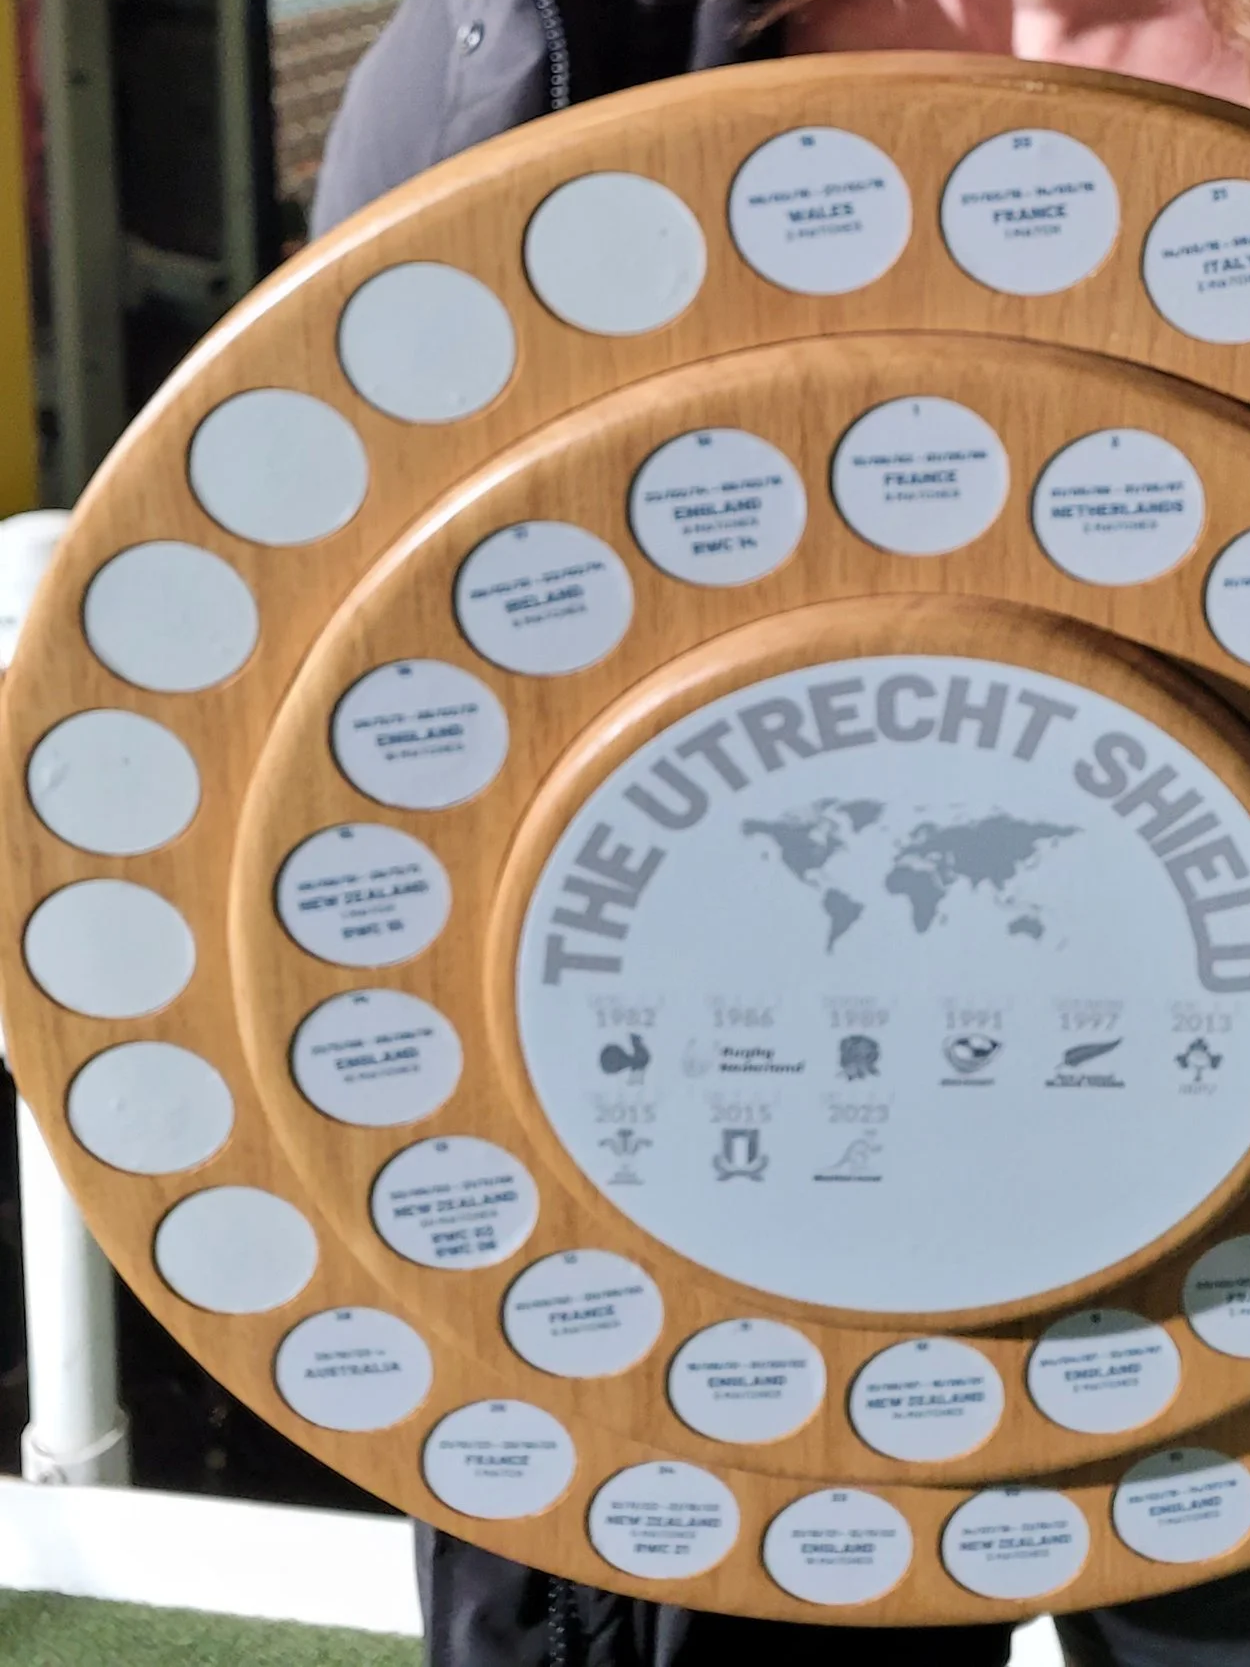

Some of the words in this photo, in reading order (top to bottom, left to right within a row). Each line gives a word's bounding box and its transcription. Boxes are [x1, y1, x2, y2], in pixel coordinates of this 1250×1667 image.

[788, 202, 855, 223] WALES
[993, 203, 1066, 223] FRANCE
[884, 470, 957, 486] FRANCE
[674, 497, 761, 519] ENGLAND
[1052, 500, 1184, 519] NETHERLANDS
[693, 539, 733, 555] RWC
[505, 584, 585, 613] IRELAND
[377, 723, 463, 746] ENGLAND
[543, 824, 668, 988] THE
[623, 673, 1077, 833] UTRECHT
[300, 896, 338, 911] NEW
[344, 880, 429, 904] ZEALAND
[596, 1007, 656, 1028] 1982
[713, 1007, 774, 1028] 1986
[830, 1008, 890, 1029] 1989
[944, 1009, 1003, 1030] 1991
[1059, 1011, 1120, 1032] 1997
[1171, 1012, 1233, 1033] 2013
[335, 1046, 420, 1070] ENGLAND
[594, 1104, 656, 1124] 2015
[709, 1104, 773, 1124] 2015
[828, 1104, 890, 1124] 2023
[393, 1201, 432, 1219] NEW
[436, 1191, 519, 1213] ZEALAND
[548, 1305, 616, 1324] FRANCE
[304, 1362, 401, 1379] AUSTRALIA
[1064, 1362, 1141, 1380] ENGLAND
[707, 1375, 787, 1388] ENGLAND
[867, 1397, 902, 1410] NEW
[907, 1392, 985, 1407] ZEALAND
[465, 1454, 531, 1466] FRANCE
[1149, 1496, 1223, 1516] ENGLAND
[605, 1516, 640, 1528] NEW
[645, 1516, 722, 1528] ZEALAND
[800, 1542, 876, 1555] ENGLAND
[958, 1537, 994, 1552] NEW
[998, 1534, 1073, 1549] ZEALAND
